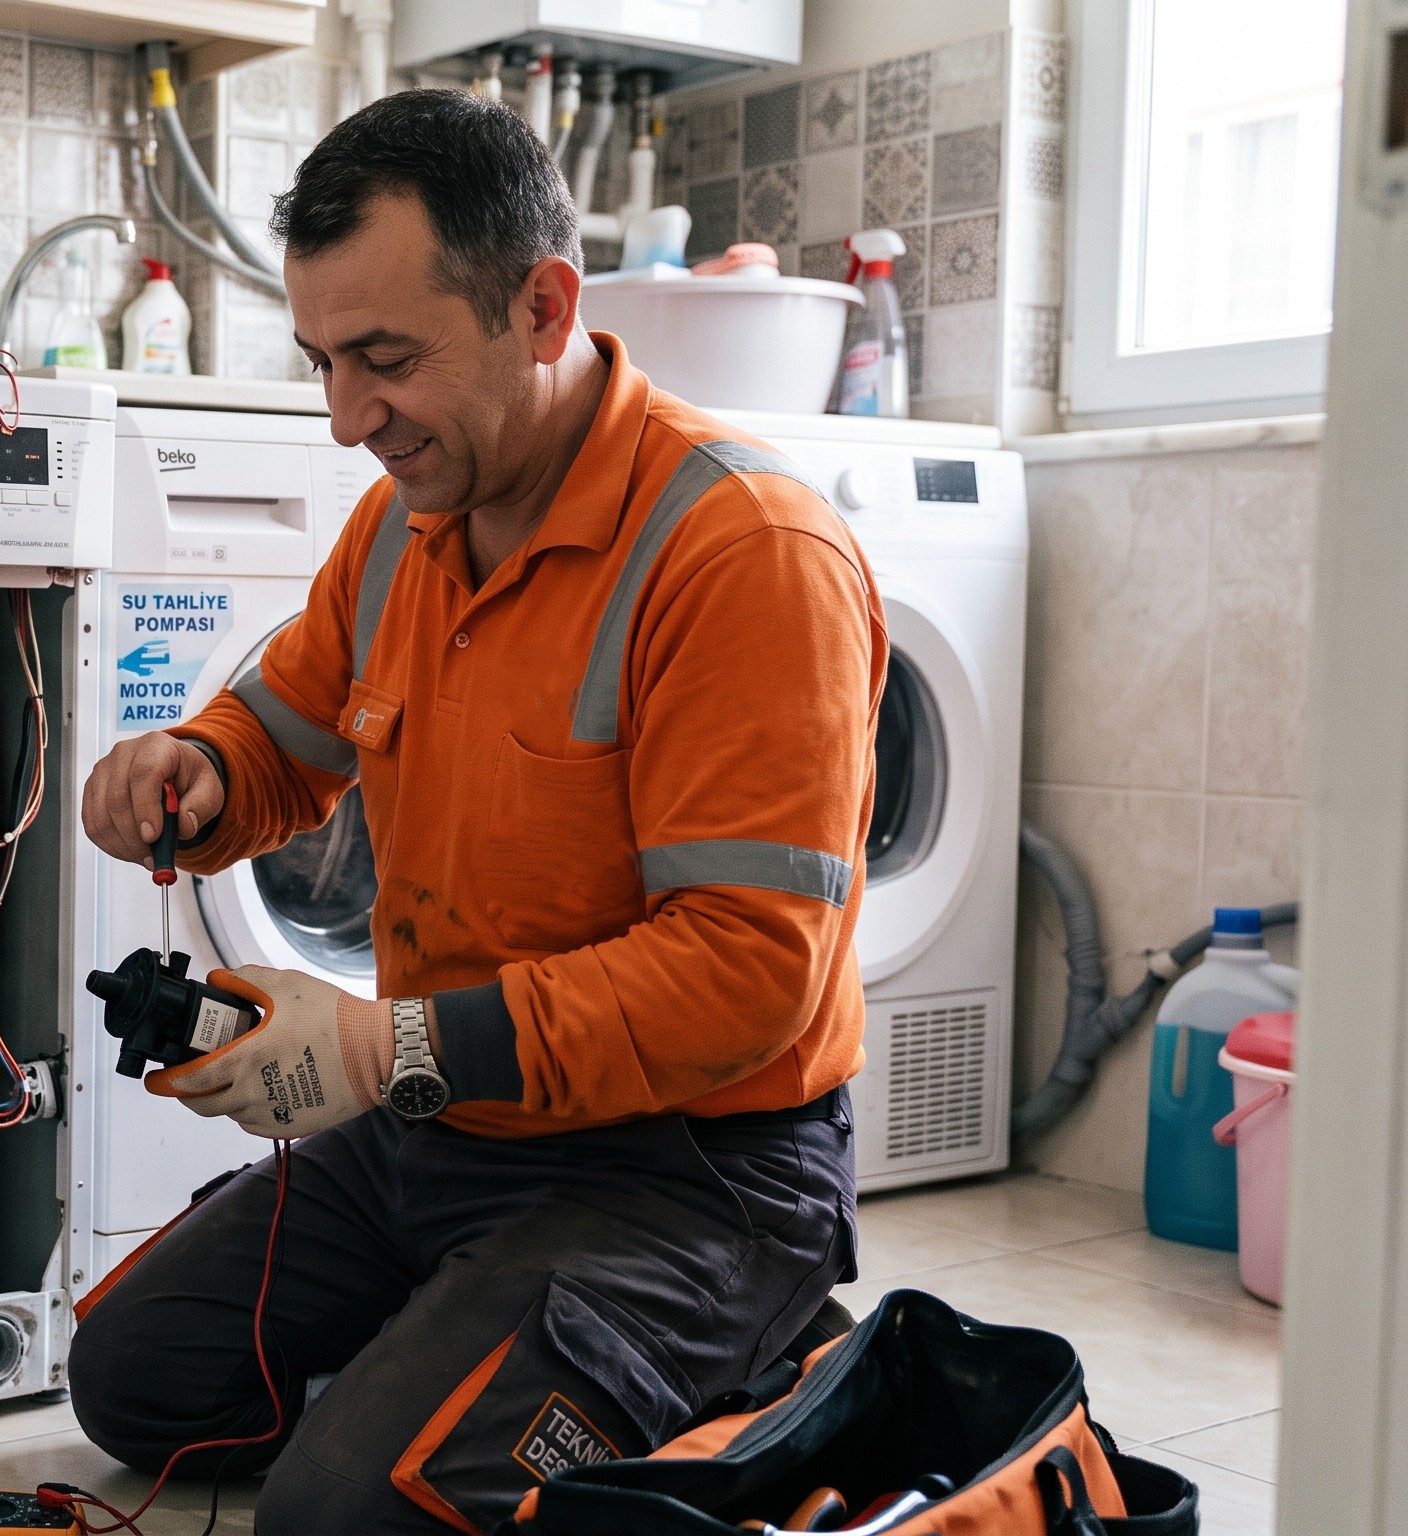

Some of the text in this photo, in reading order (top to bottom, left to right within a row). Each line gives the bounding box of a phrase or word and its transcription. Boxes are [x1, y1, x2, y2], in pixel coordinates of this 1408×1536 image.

[157, 448, 196, 464] beko
[122, 591, 228, 610] SU TAHLİYE
[135, 617, 214, 632] POMPASI
[120, 683, 186, 698] MOTOR
[546, 1407, 610, 1466] TEKNİ
